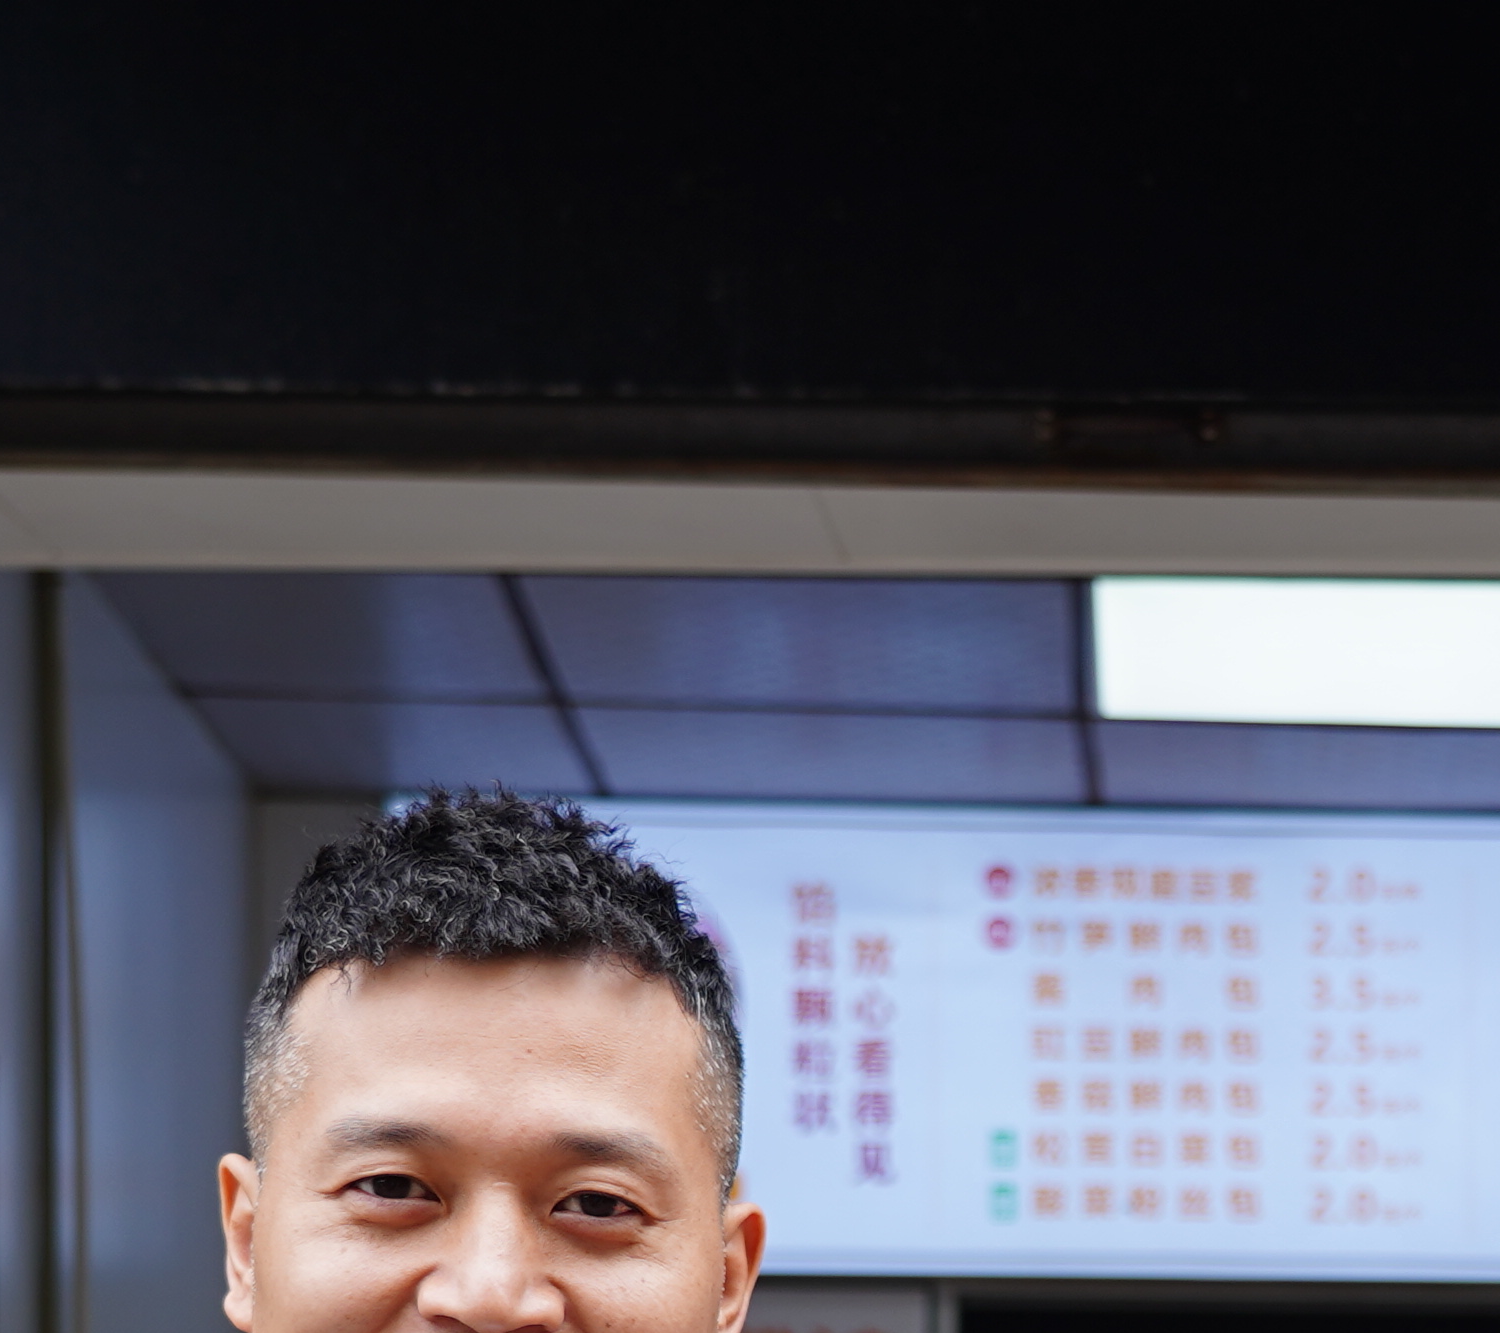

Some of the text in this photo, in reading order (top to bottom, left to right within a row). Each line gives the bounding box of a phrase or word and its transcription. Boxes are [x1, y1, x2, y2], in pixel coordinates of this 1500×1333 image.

[853, 934, 895, 1185] 放心看得见
